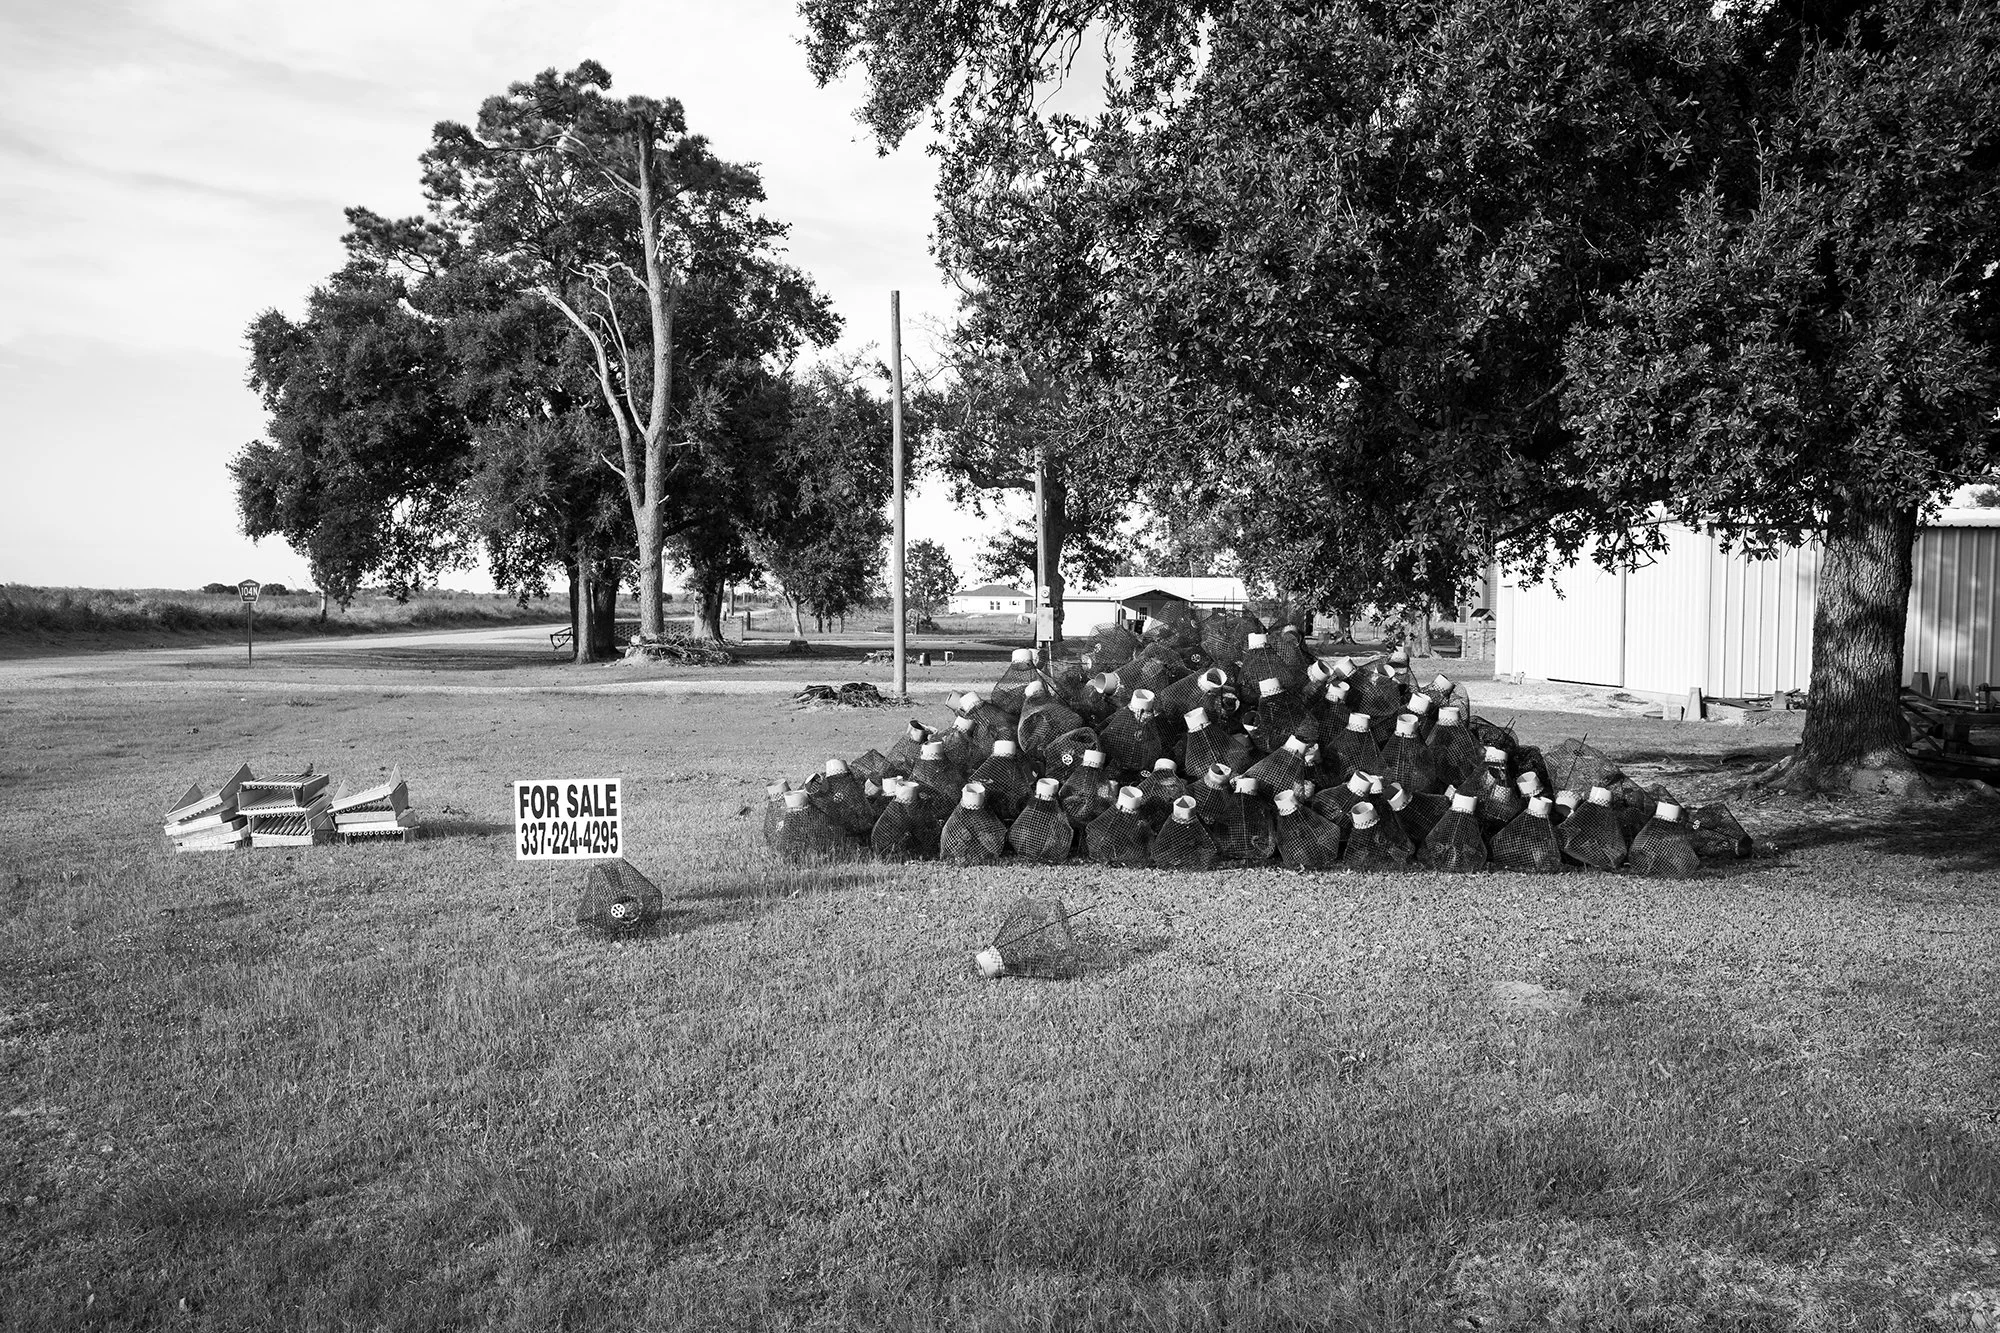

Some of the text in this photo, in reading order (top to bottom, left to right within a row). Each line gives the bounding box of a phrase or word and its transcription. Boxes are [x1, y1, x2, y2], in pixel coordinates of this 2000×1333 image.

[520, 784, 617, 819] FOR SALE
[521, 821, 618, 855] 337-224-4295
